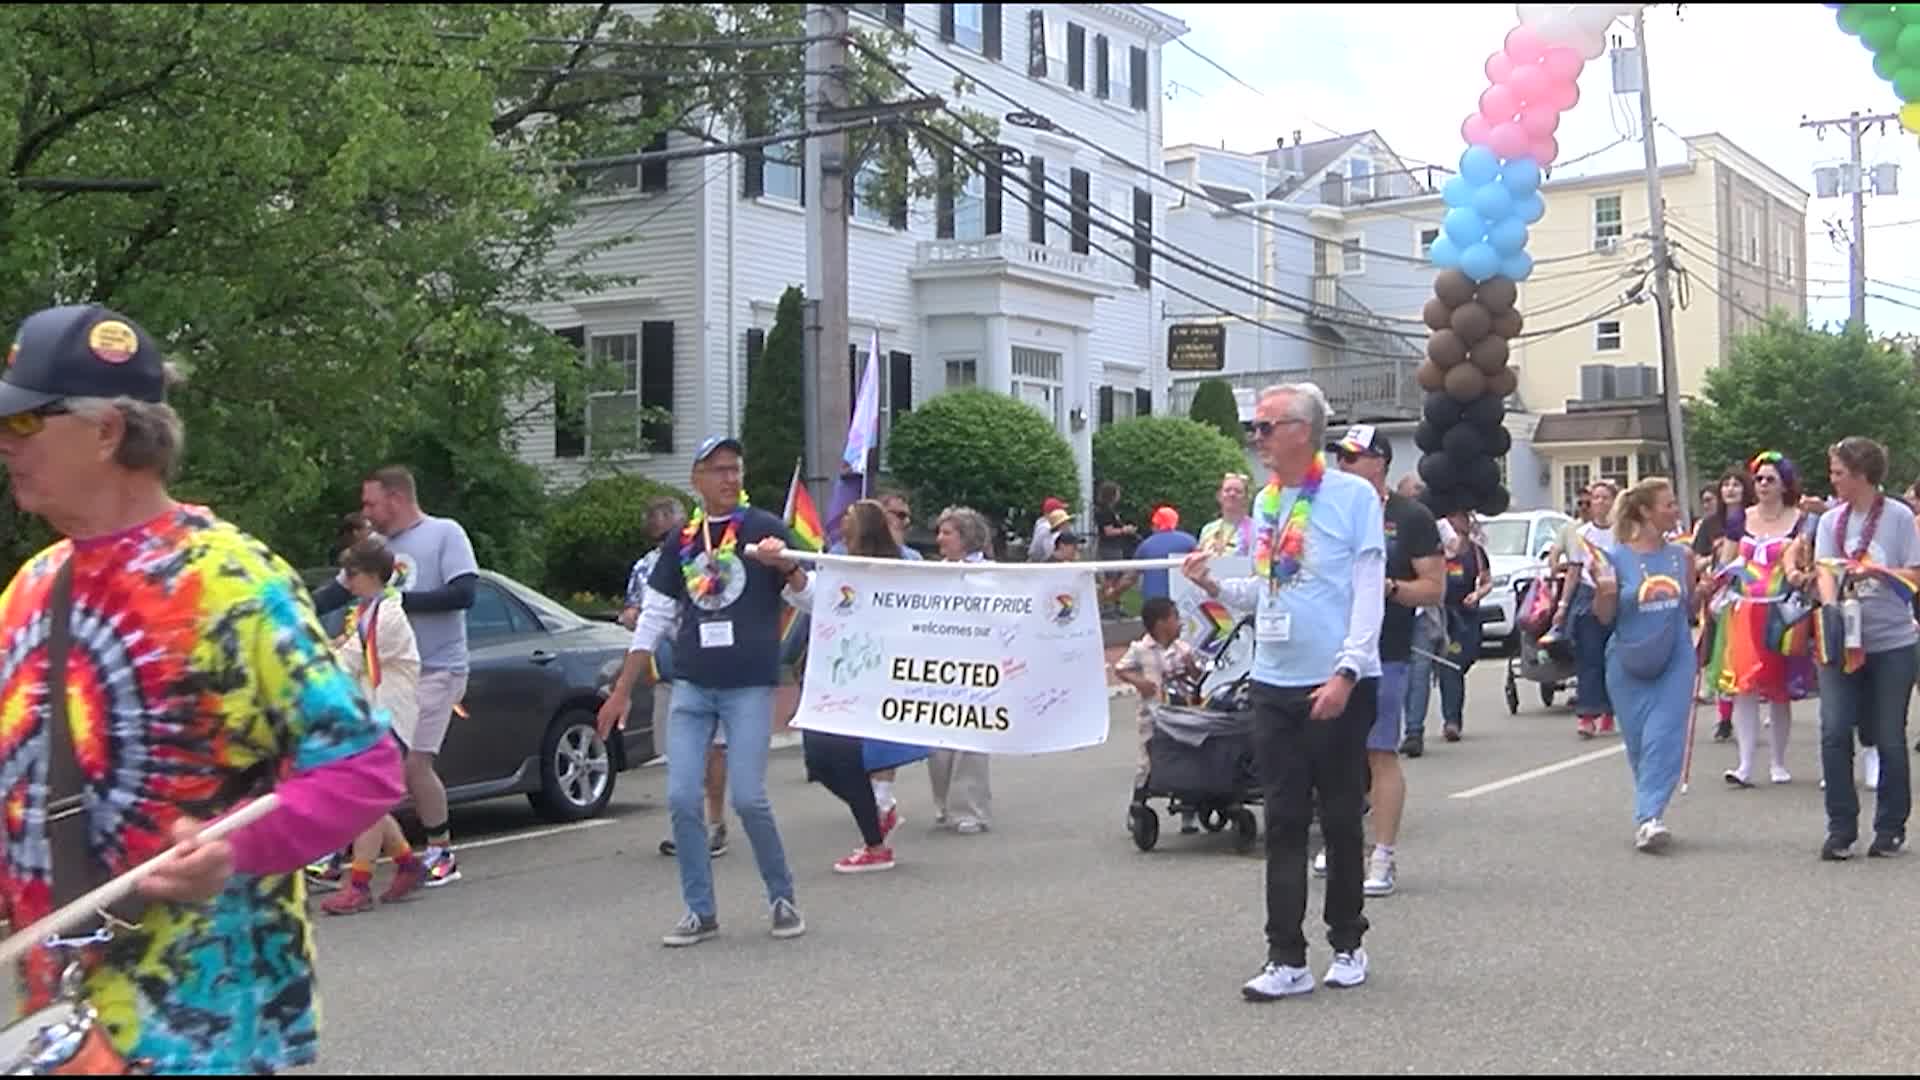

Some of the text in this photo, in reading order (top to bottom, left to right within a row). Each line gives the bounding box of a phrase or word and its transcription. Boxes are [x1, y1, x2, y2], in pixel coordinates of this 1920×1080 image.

[872, 592, 1033, 614] NEWBURYPORT PRIDE
[912, 621, 972, 636] welcomes
[974, 627, 991, 637] our
[892, 657, 999, 688] ELECTED
[882, 697, 1009, 731] OFFICIALS
